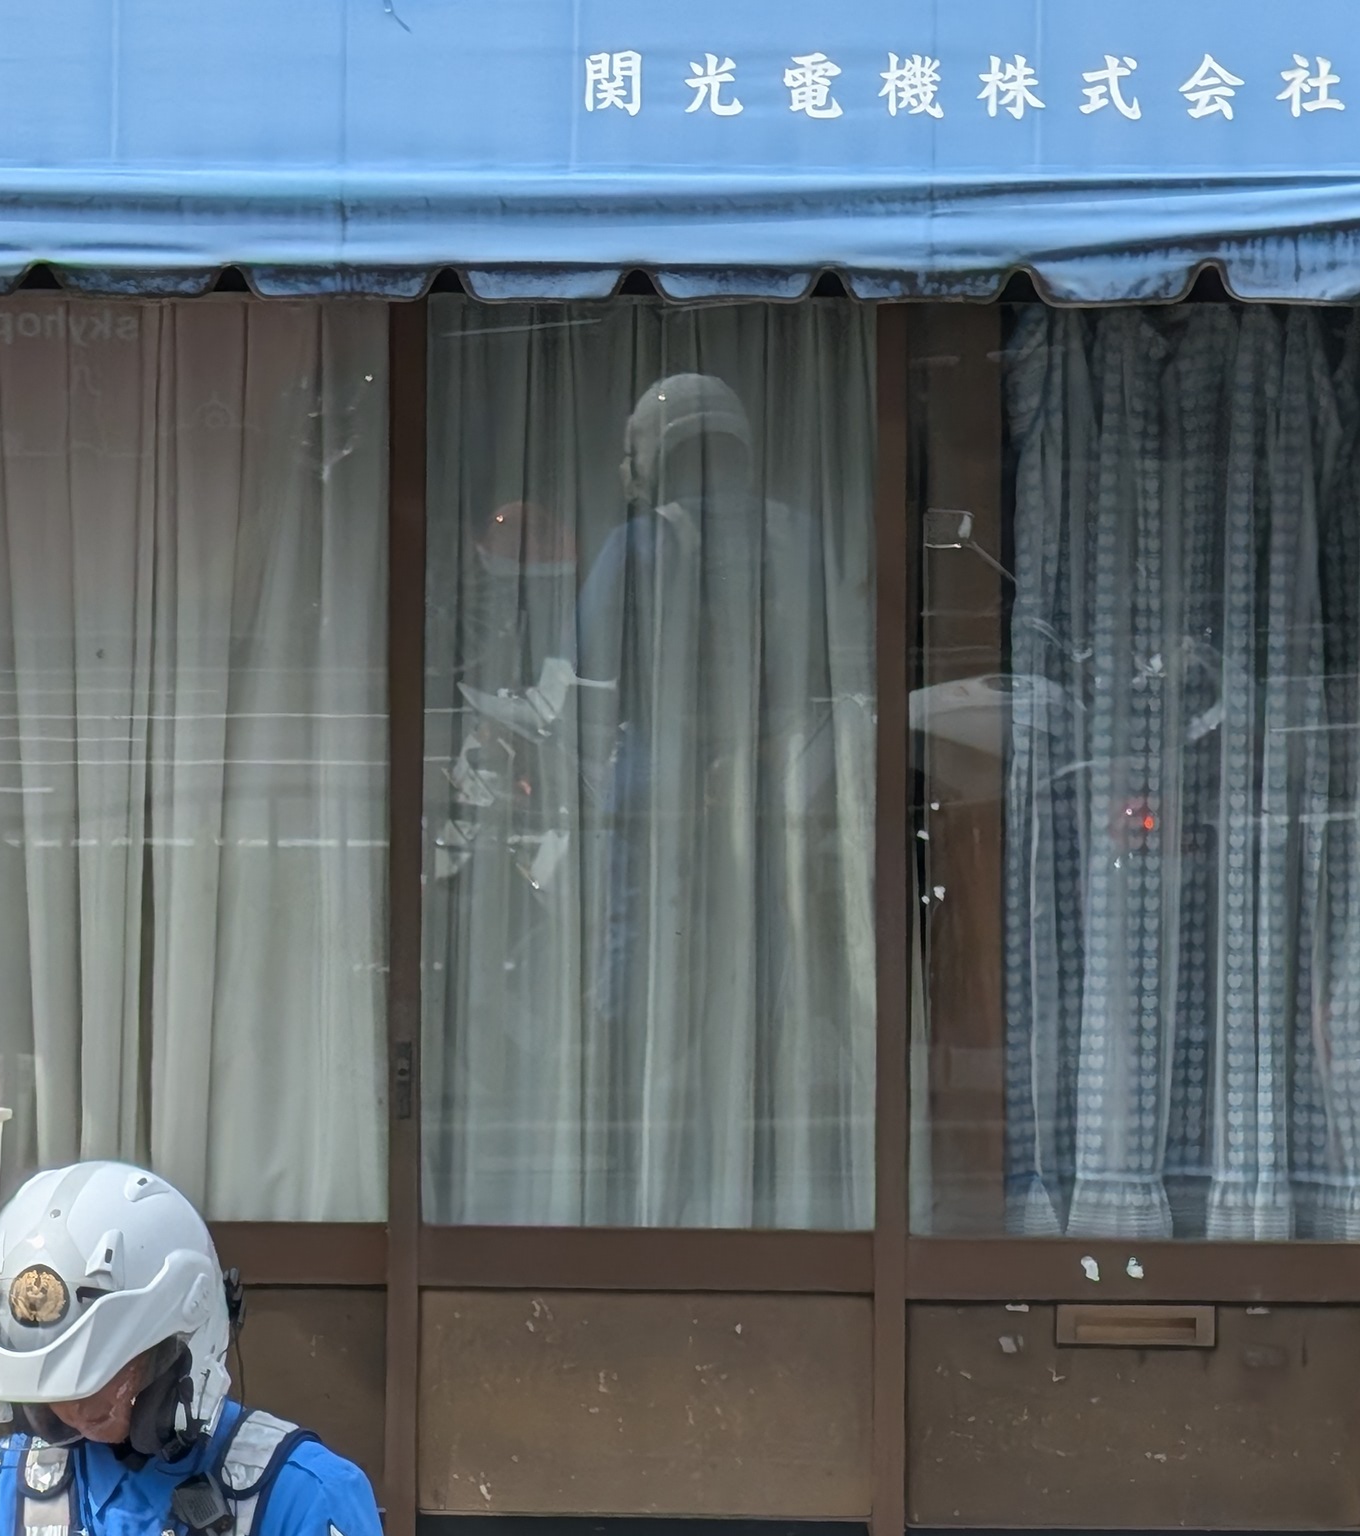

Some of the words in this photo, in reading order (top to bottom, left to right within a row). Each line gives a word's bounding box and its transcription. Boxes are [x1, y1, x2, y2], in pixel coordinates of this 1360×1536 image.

[583, 50, 1346, 121] 関光電機株式会社
